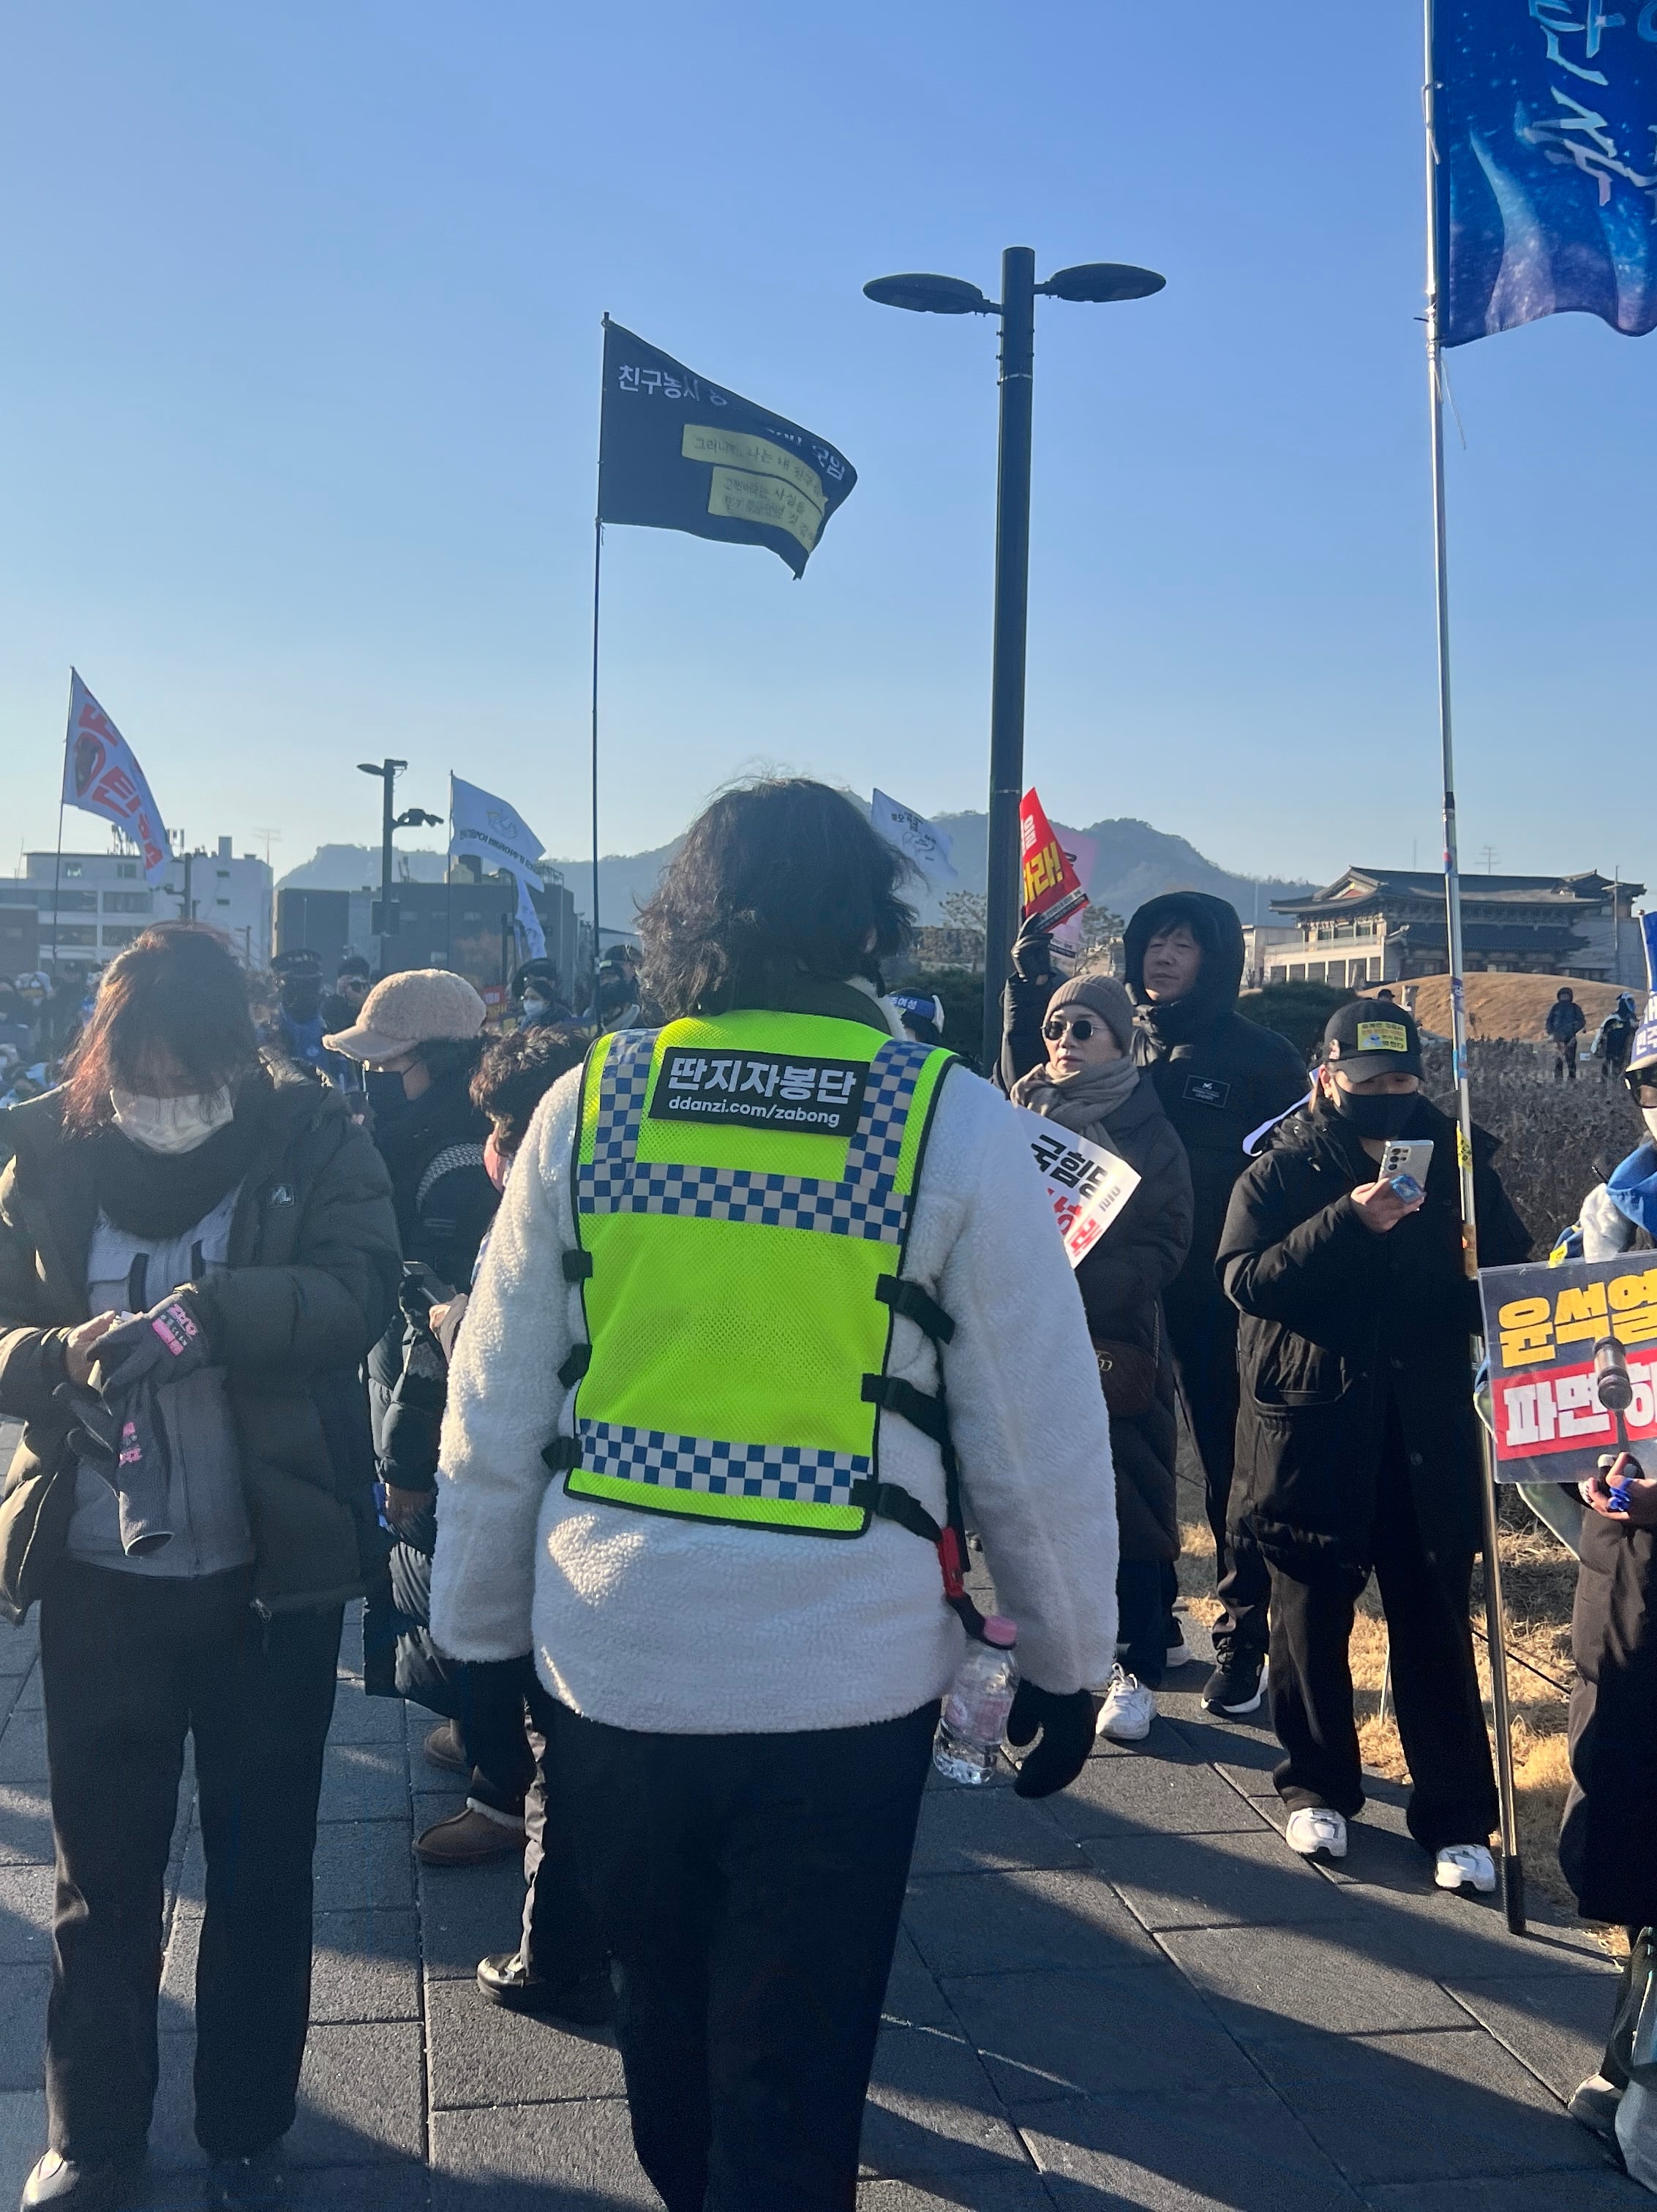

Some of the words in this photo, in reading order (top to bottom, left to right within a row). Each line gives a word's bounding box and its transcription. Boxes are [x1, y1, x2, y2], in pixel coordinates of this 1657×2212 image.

[668, 1057, 857, 1105] 딴지자봉단
[668, 1096, 841, 1128] ddanzi.com/zabong
[1498, 1268, 1657, 1369] 윤석열
